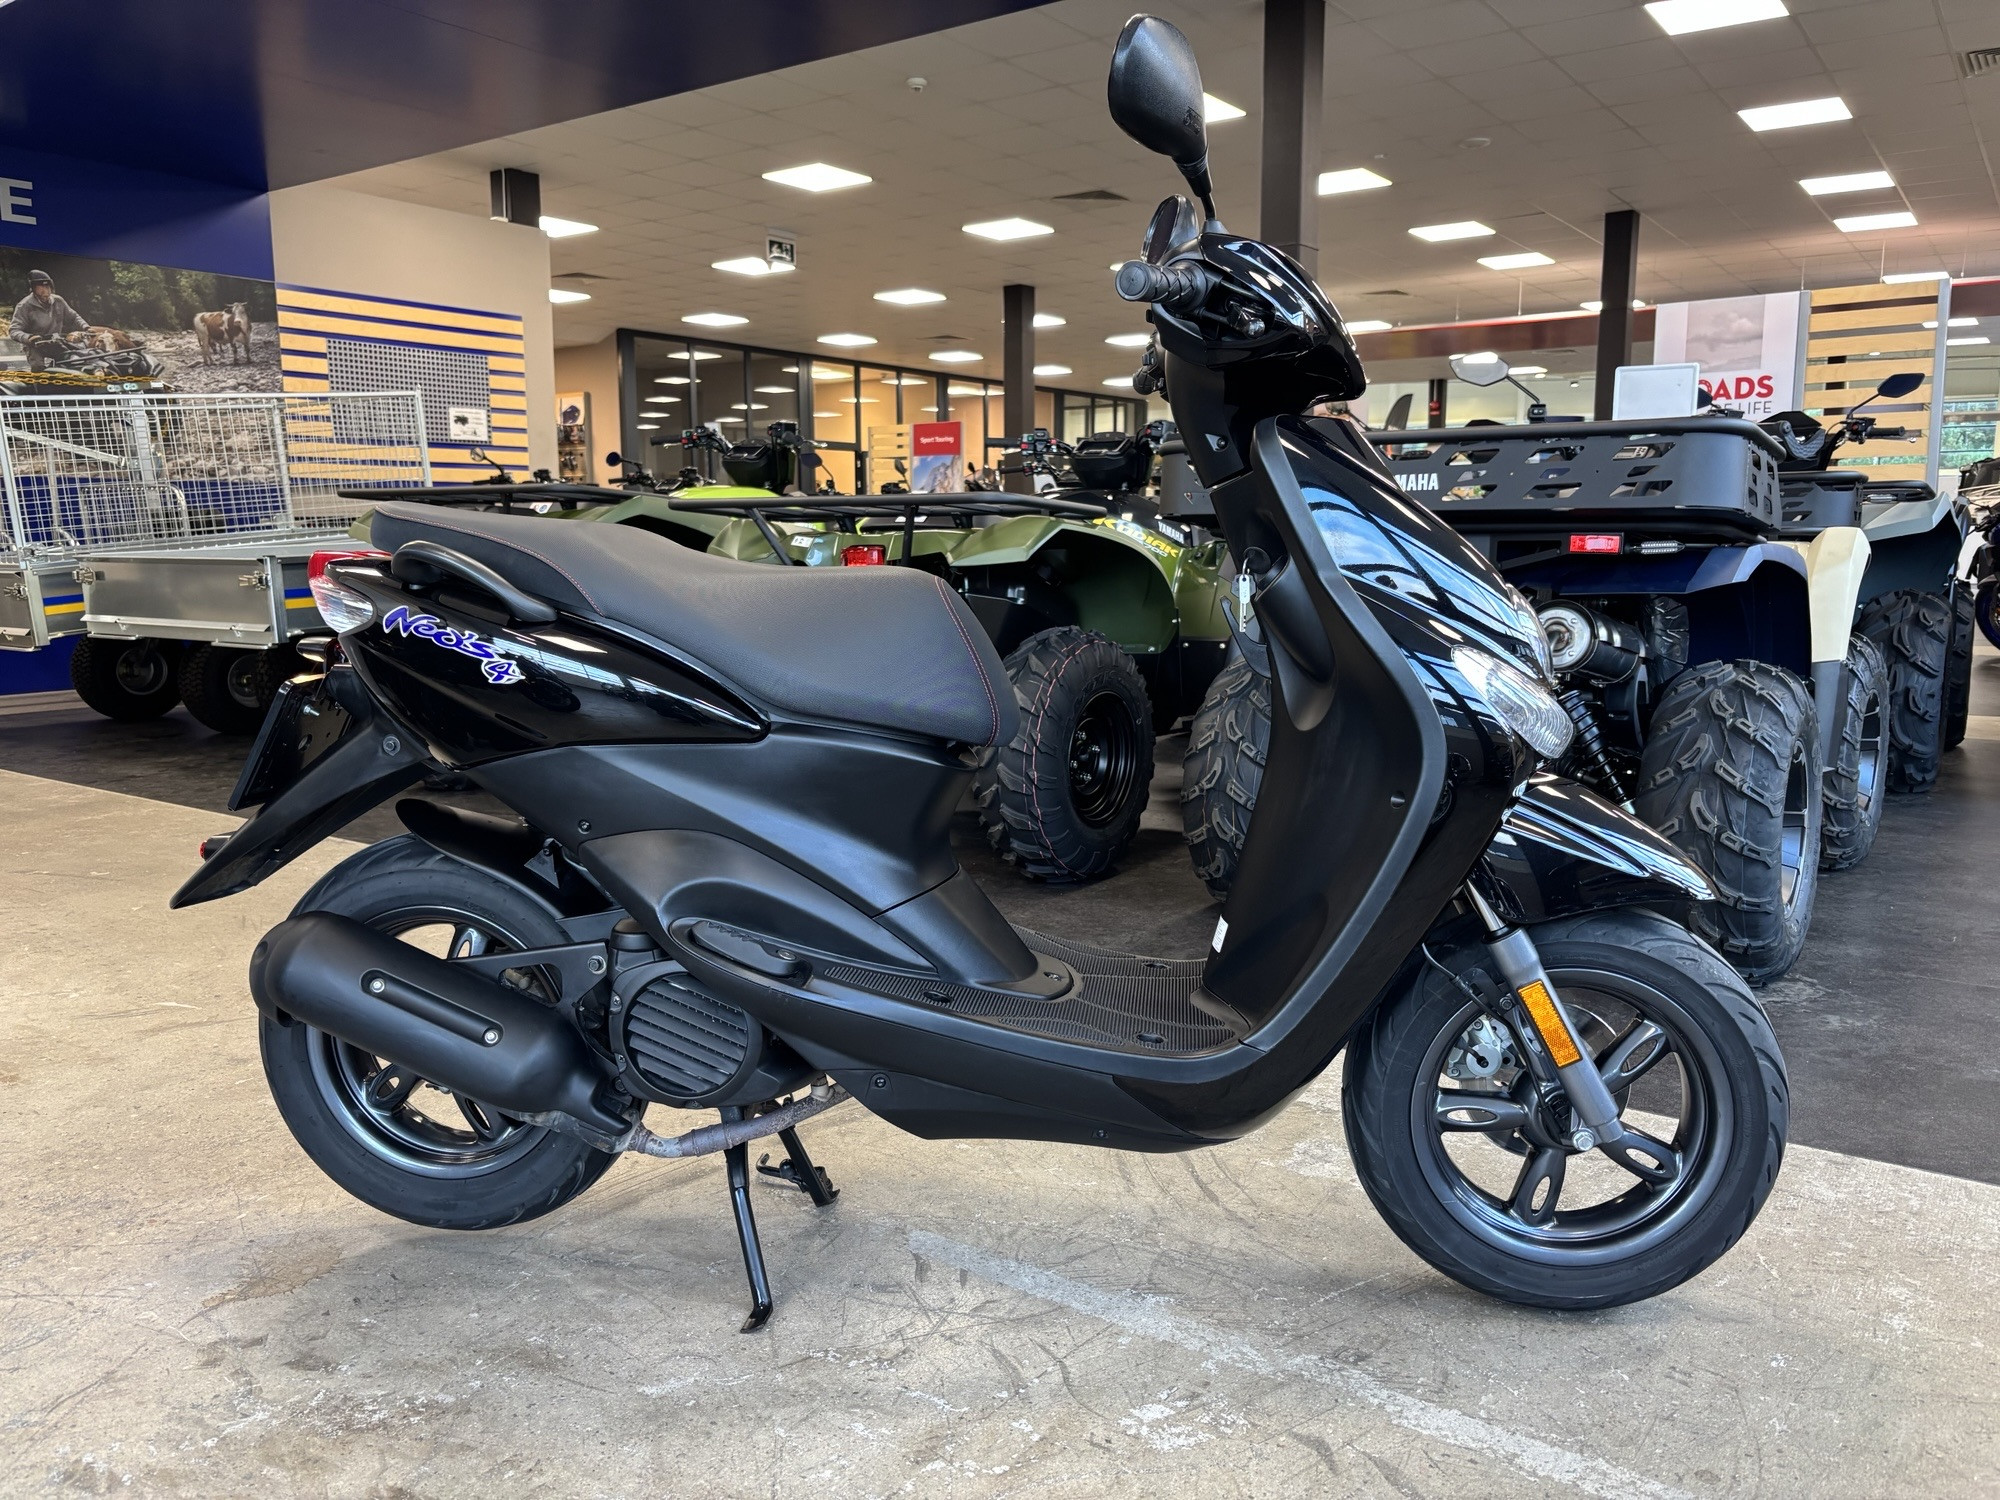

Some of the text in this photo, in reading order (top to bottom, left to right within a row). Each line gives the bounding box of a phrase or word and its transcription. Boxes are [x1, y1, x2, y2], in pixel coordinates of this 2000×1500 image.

[0, 177, 37, 225] E
[1092, 518, 1179, 557] KODIAK
[1158, 521, 1184, 544] YAMAHA
[1143, 542, 1168, 557] 700
[481, 659, 526, 684] 4
